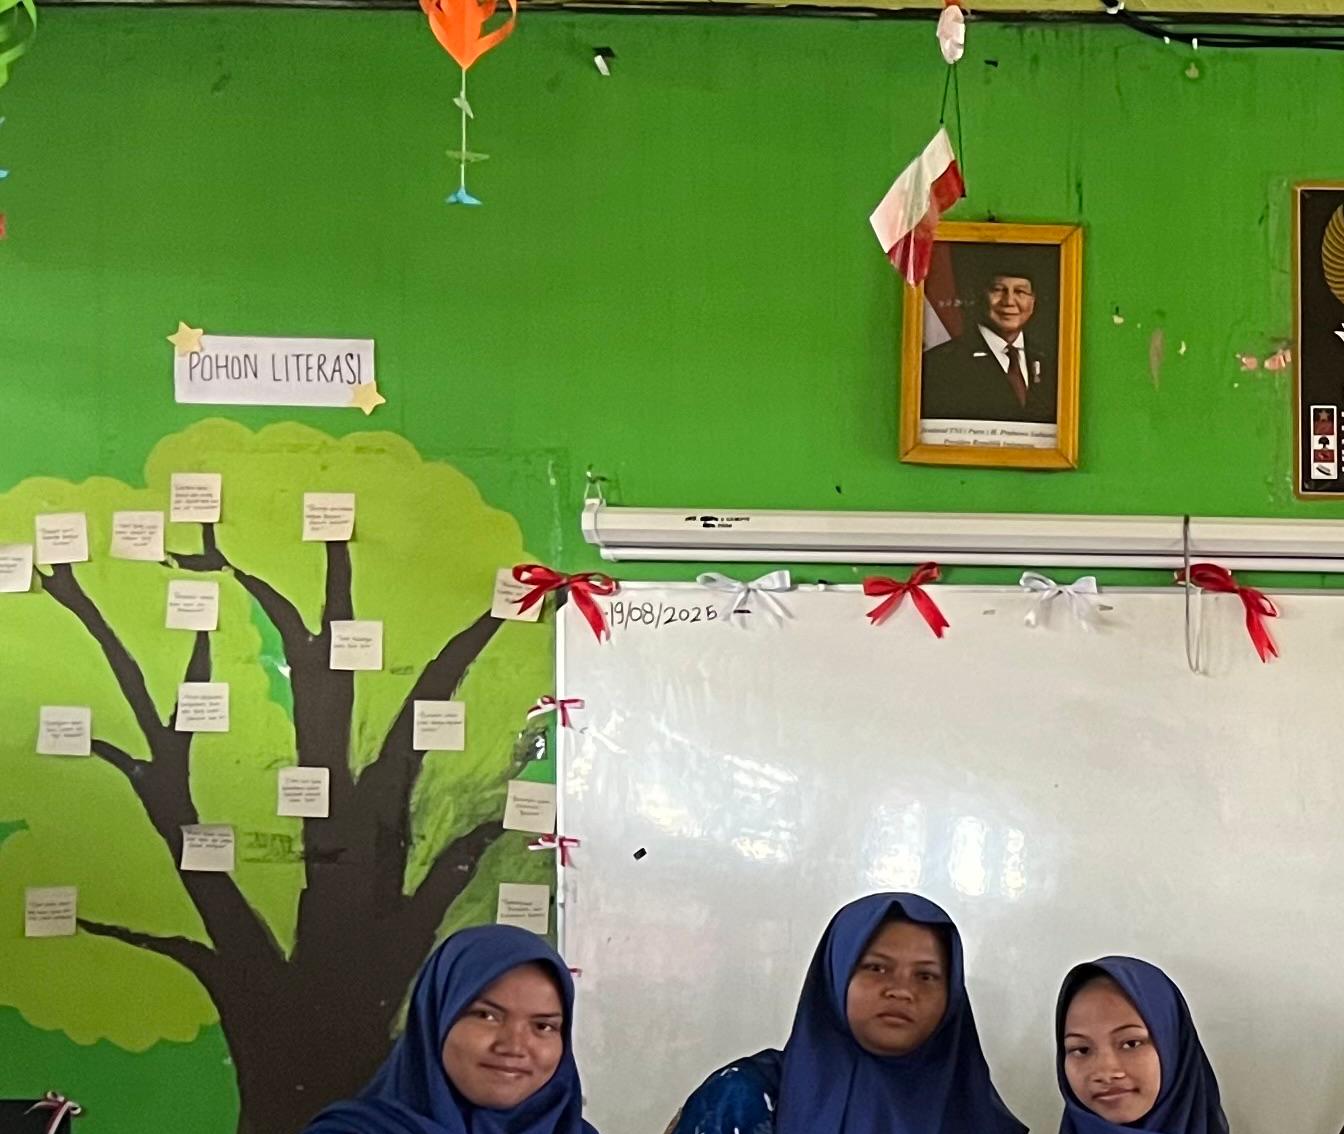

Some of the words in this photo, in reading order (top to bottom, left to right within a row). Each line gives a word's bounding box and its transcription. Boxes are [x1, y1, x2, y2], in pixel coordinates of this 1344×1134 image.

[189, 351, 258, 382] POHON
[272, 353, 362, 385] LITERASI
[610, 601, 718, 630] 19/08/2025
